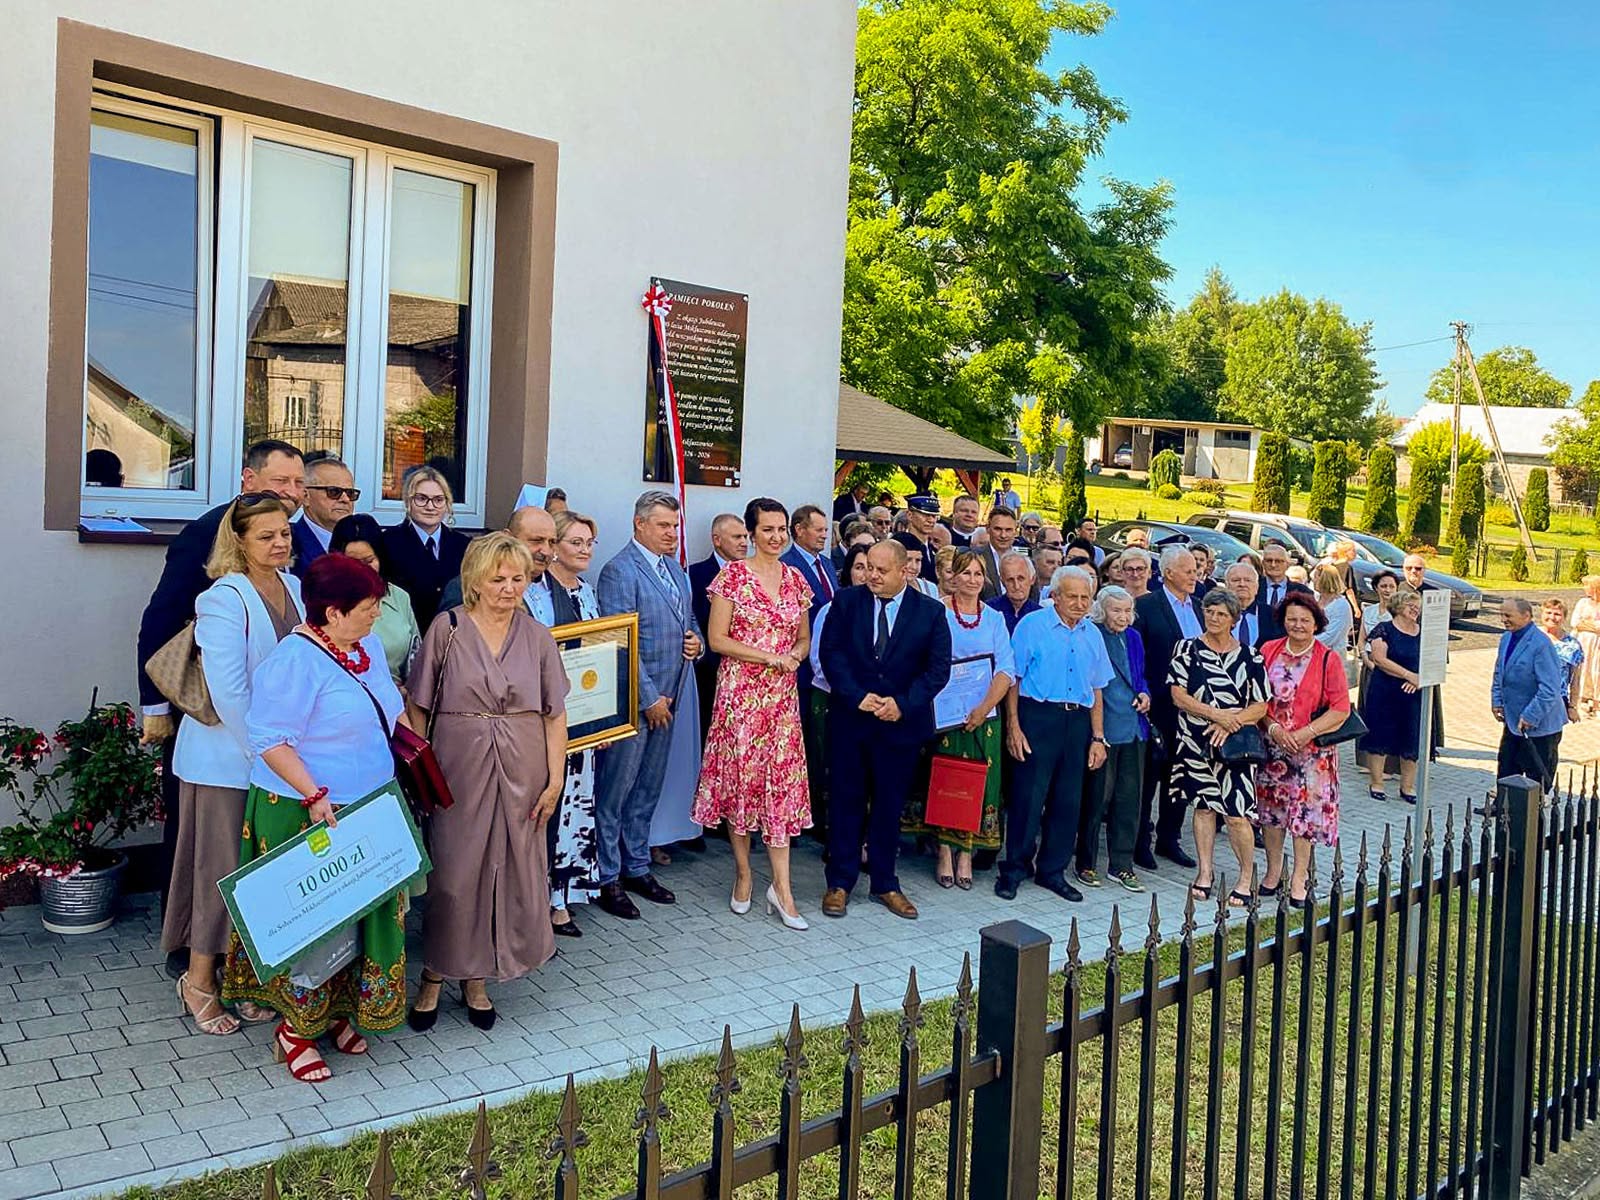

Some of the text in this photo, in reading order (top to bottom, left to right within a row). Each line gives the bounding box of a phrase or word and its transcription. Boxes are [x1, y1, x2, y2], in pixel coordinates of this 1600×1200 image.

[668, 293, 735, 311] PAMIĘCI POKOLEŃ
[296, 874, 317, 898] 10
[319, 855, 348, 884] 000
[351, 845, 366, 866] zł
